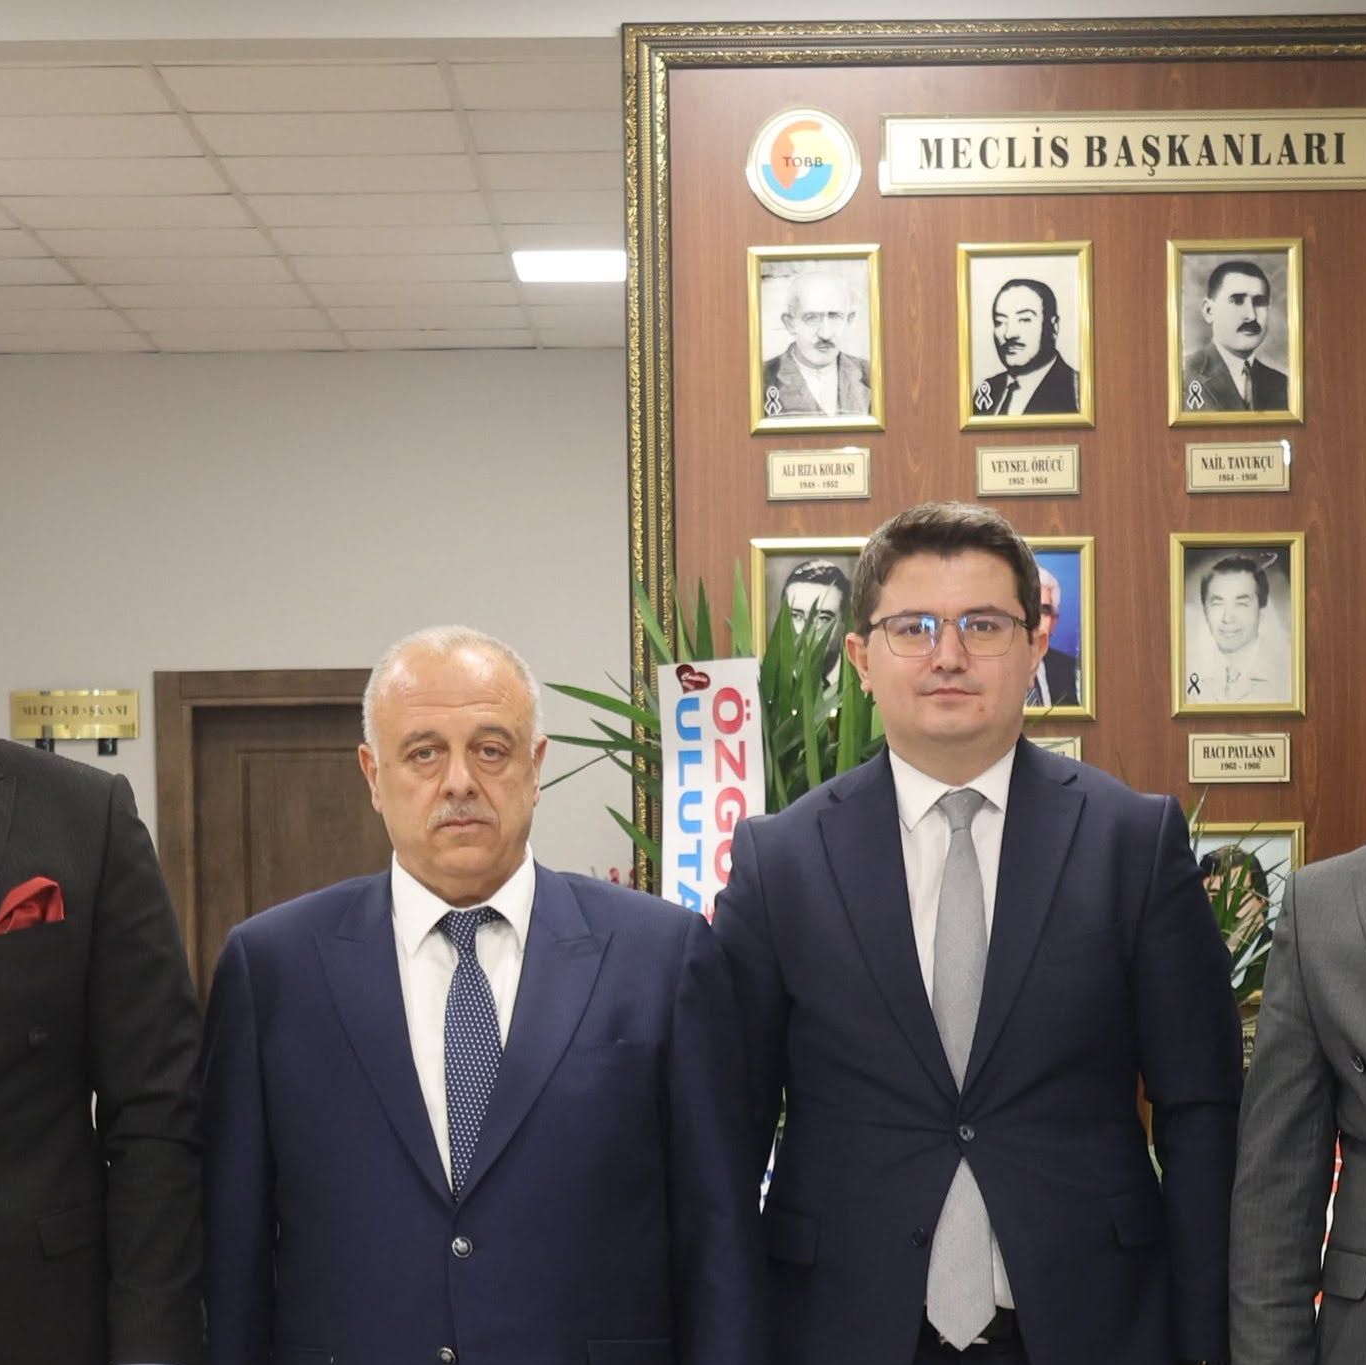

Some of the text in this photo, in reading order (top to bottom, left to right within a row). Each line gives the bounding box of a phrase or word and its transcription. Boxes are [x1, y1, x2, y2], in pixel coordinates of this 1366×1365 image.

[782, 156, 824, 168] TOBB
[919, 126, 1347, 178] MECLİS BAŞKANLARI
[675, 697, 702, 914] ULUTA
